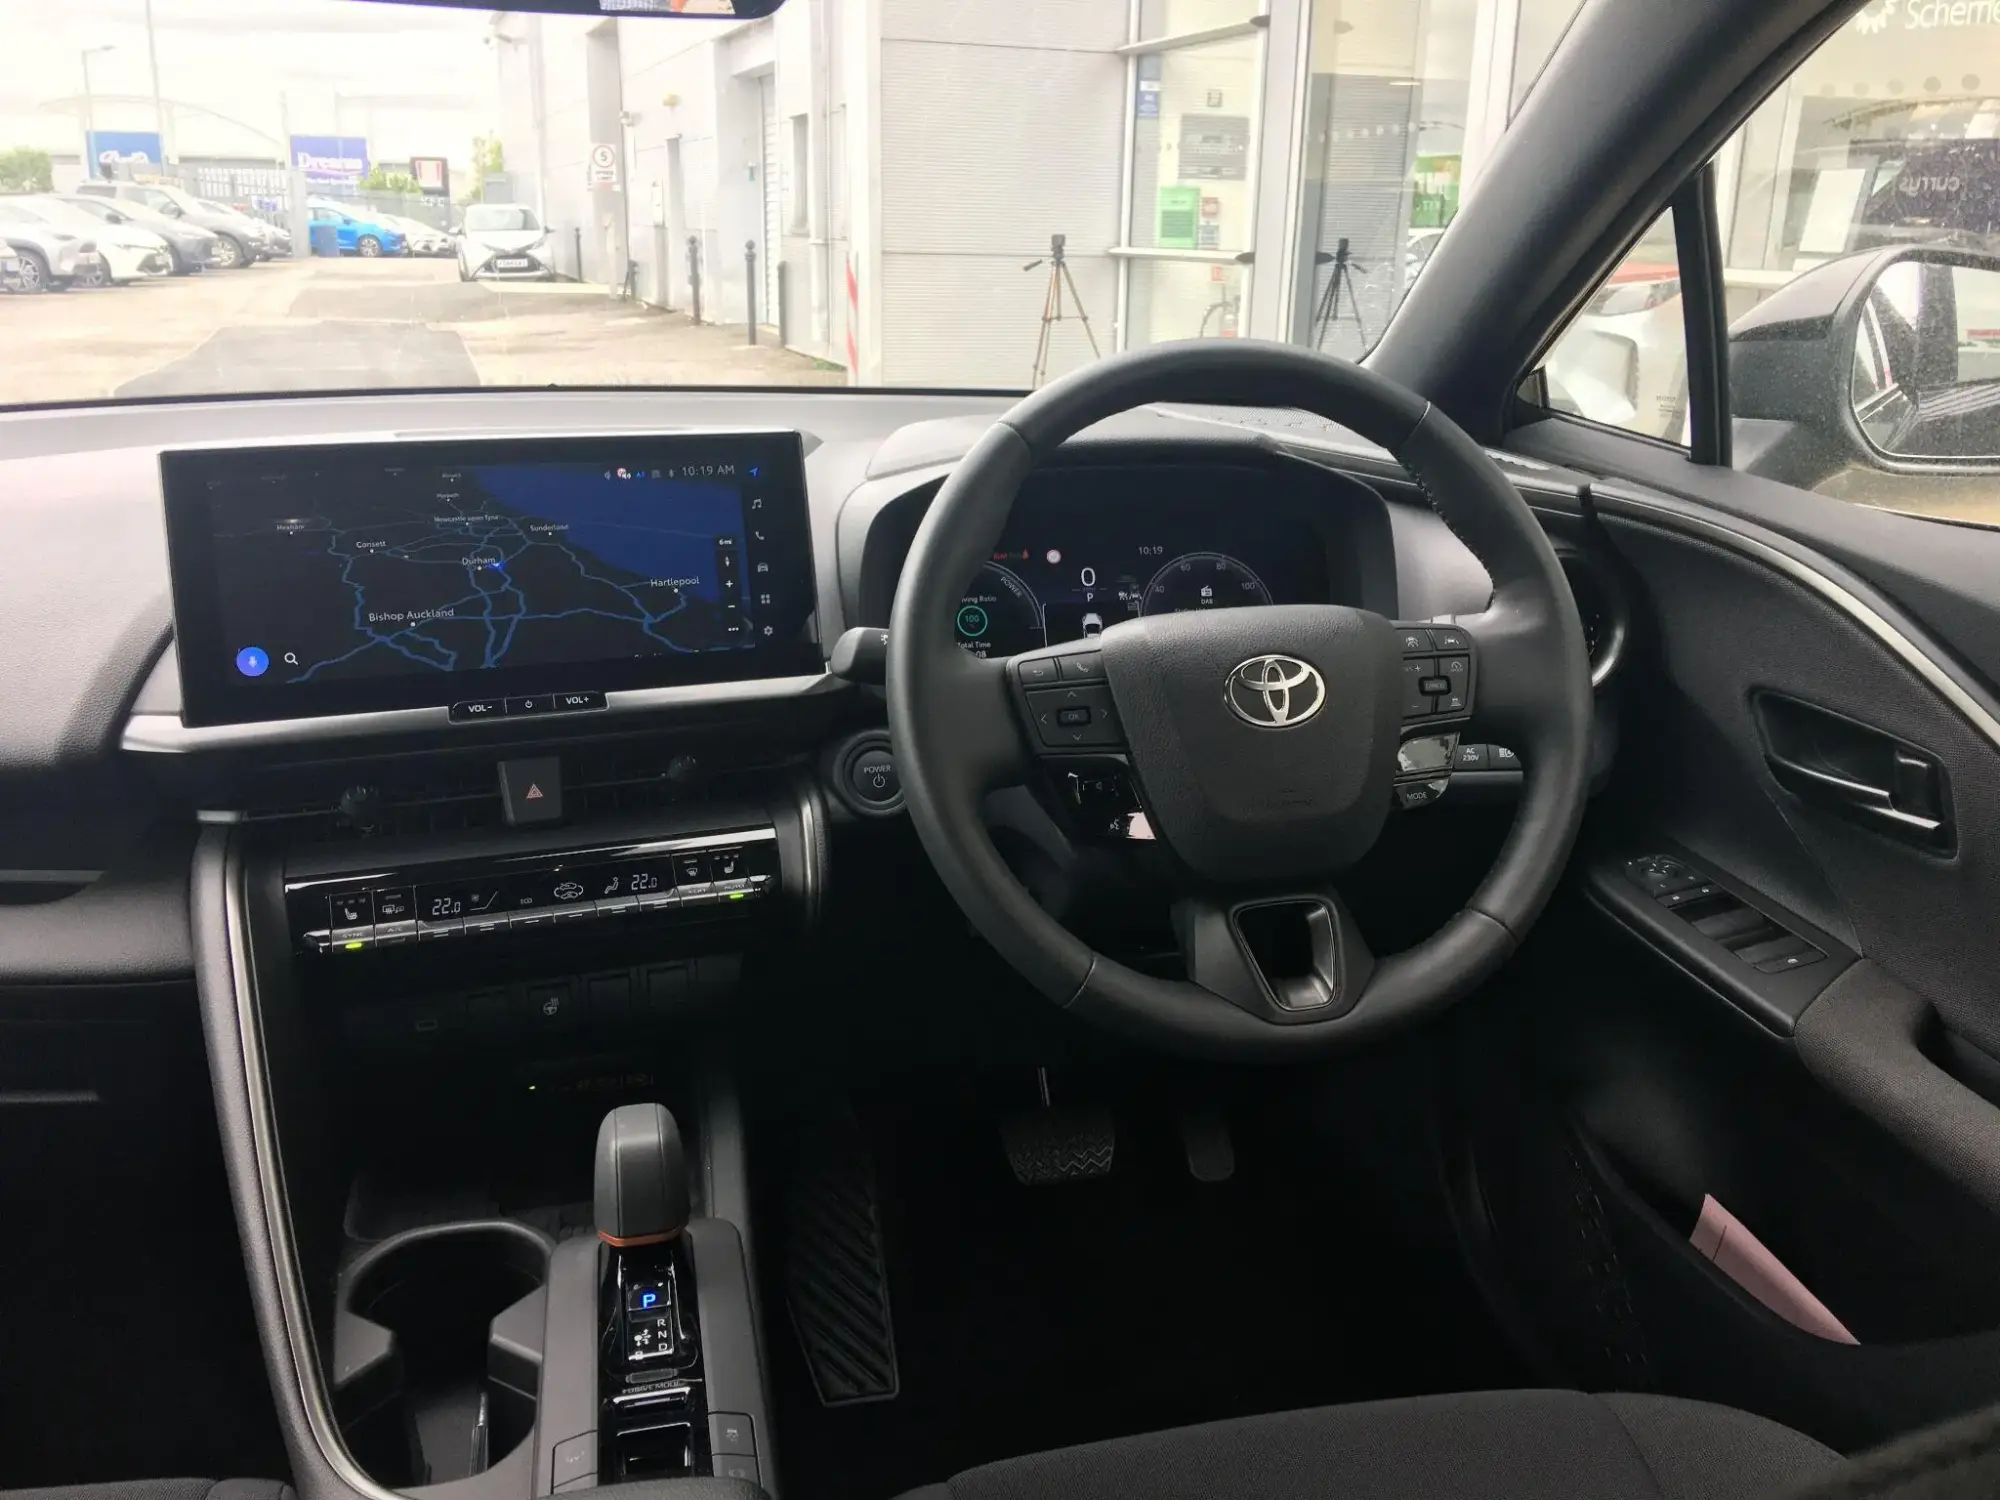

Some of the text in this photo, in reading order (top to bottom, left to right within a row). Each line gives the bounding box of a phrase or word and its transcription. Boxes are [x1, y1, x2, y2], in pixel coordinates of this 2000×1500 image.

[601, 151, 608, 162] 5
[682, 465, 736, 477] 10:19 AM
[529, 524, 569, 532] Sunderland
[1138, 546, 1163, 555] 10:19
[462, 557, 496, 565] Durham
[1180, 563, 1191, 571] 60
[1216, 562, 1226, 571] 80
[650, 576, 700, 588] Hartlepool
[1081, 567, 1096, 587] 0
[1000, 576, 1023, 598] POWER
[1242, 582, 1255, 590] 100
[1086, 592, 1094, 602] P
[368, 608, 455, 622] Bishop Auckland
[965, 614, 979, 623] 100
[1463, 754, 1480, 762] 230V
[864, 764, 892, 774] POWER
[1406, 791, 1428, 800] MODE
[631, 873, 658, 891] 22.0
[432, 898, 461, 916] 22.0
[643, 1293, 656, 1308] P
[657, 1318, 666, 1327] R
[657, 1330, 667, 1339] N
[658, 1342, 668, 1352] D
